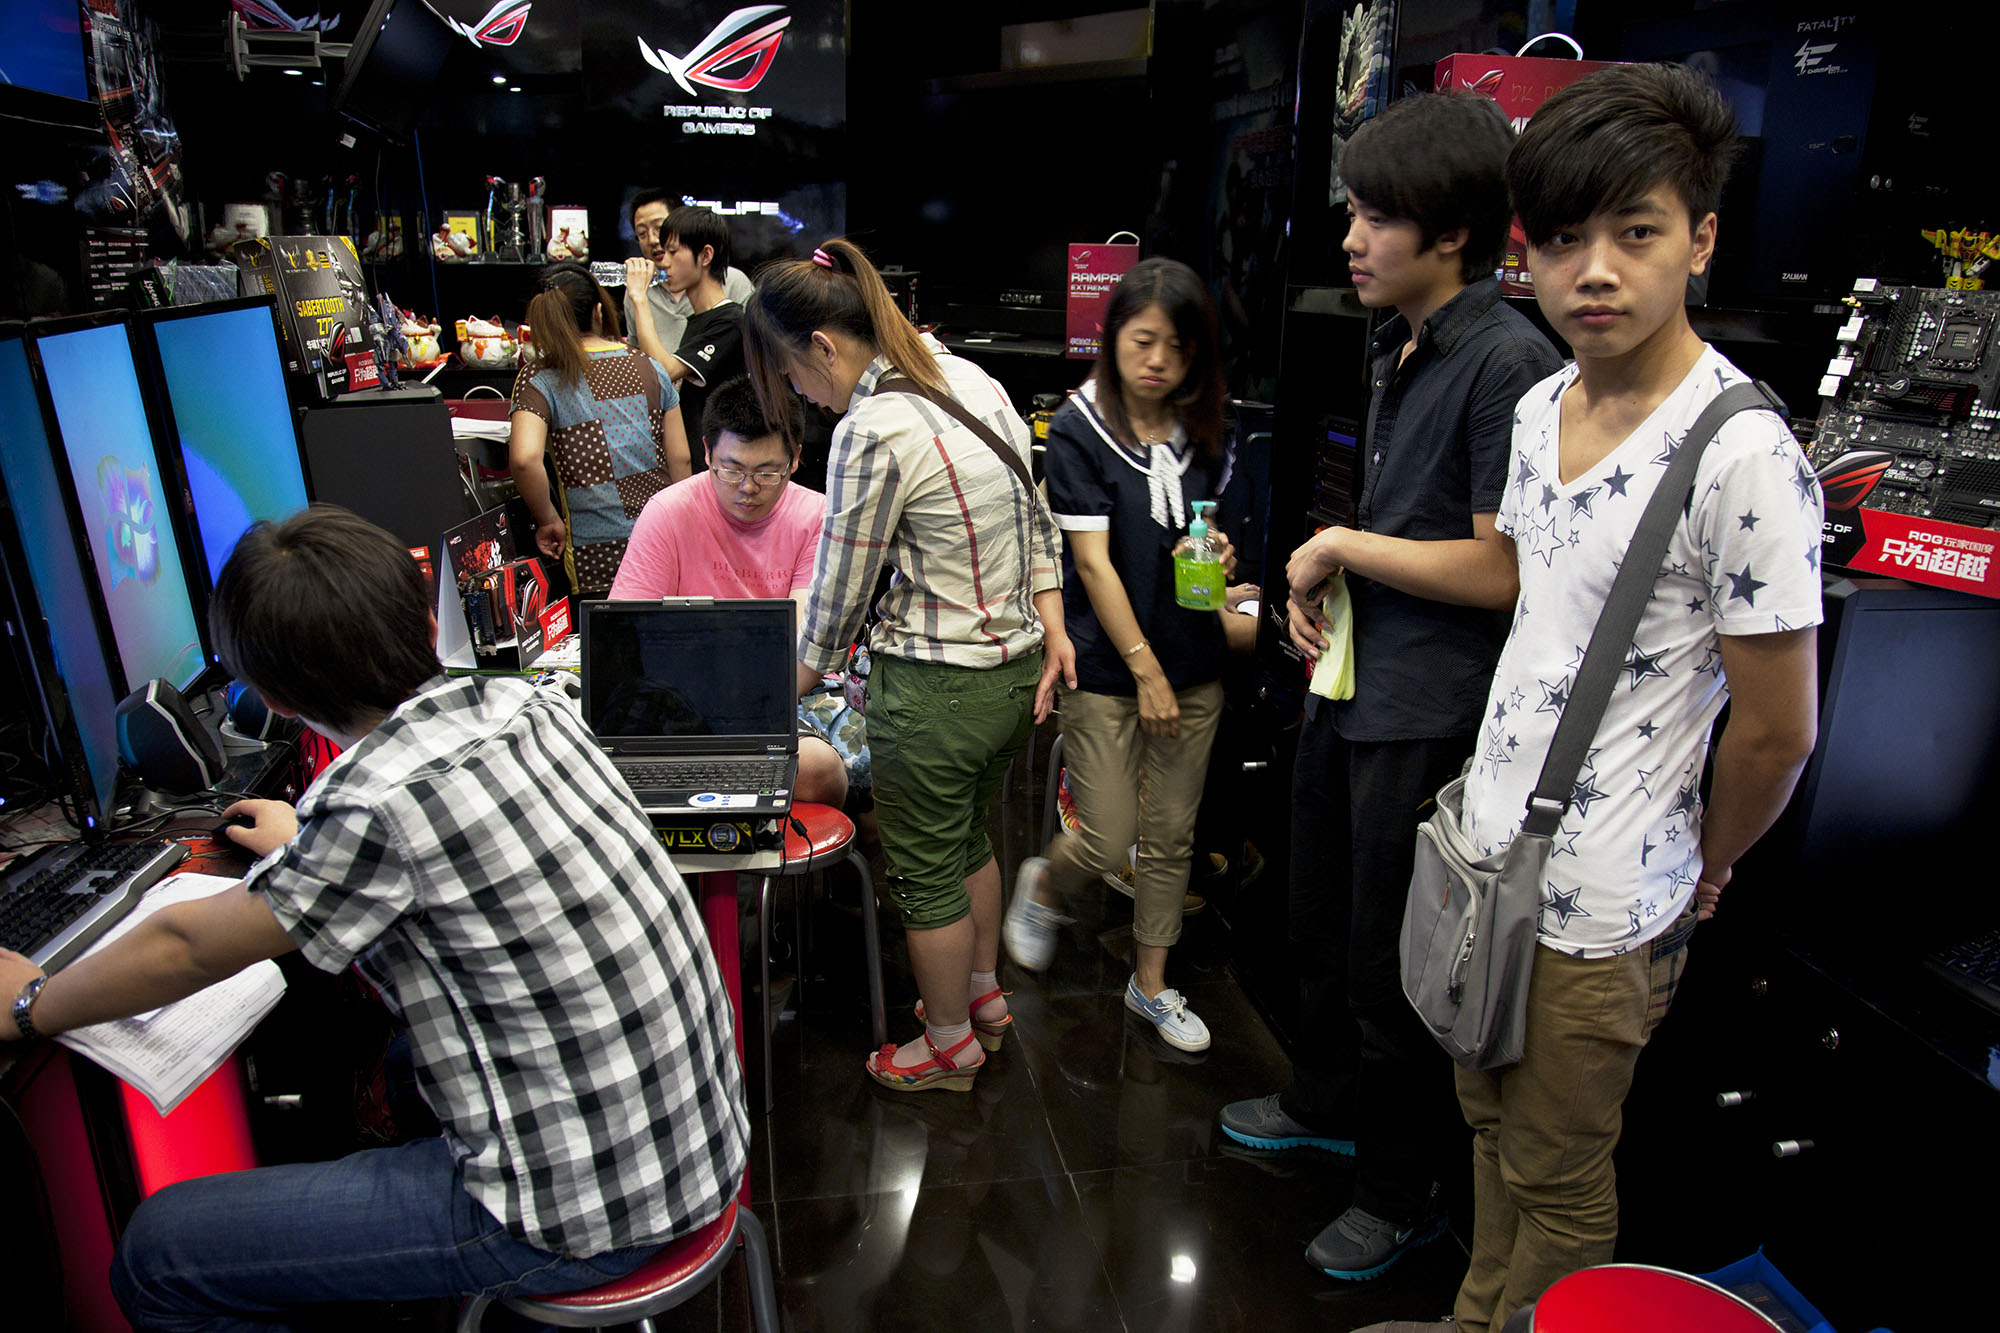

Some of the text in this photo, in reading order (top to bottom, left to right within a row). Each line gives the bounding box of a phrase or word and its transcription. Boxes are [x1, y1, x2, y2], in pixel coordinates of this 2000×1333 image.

[663, 105, 773, 120] REPUBLIC OF
[682, 121, 756, 136] GAMERS
[1070, 272, 1125, 283] RAMPA
[1781, 272, 1808, 283] ZALMAN
[1070, 284, 1111, 292] EXTREME
[296, 296, 345, 318] SABERTOOTH
[1833, 524, 1853, 534] OF
[1878, 538, 1991, 583] 只为超越
[679, 831, 704, 845] LX
